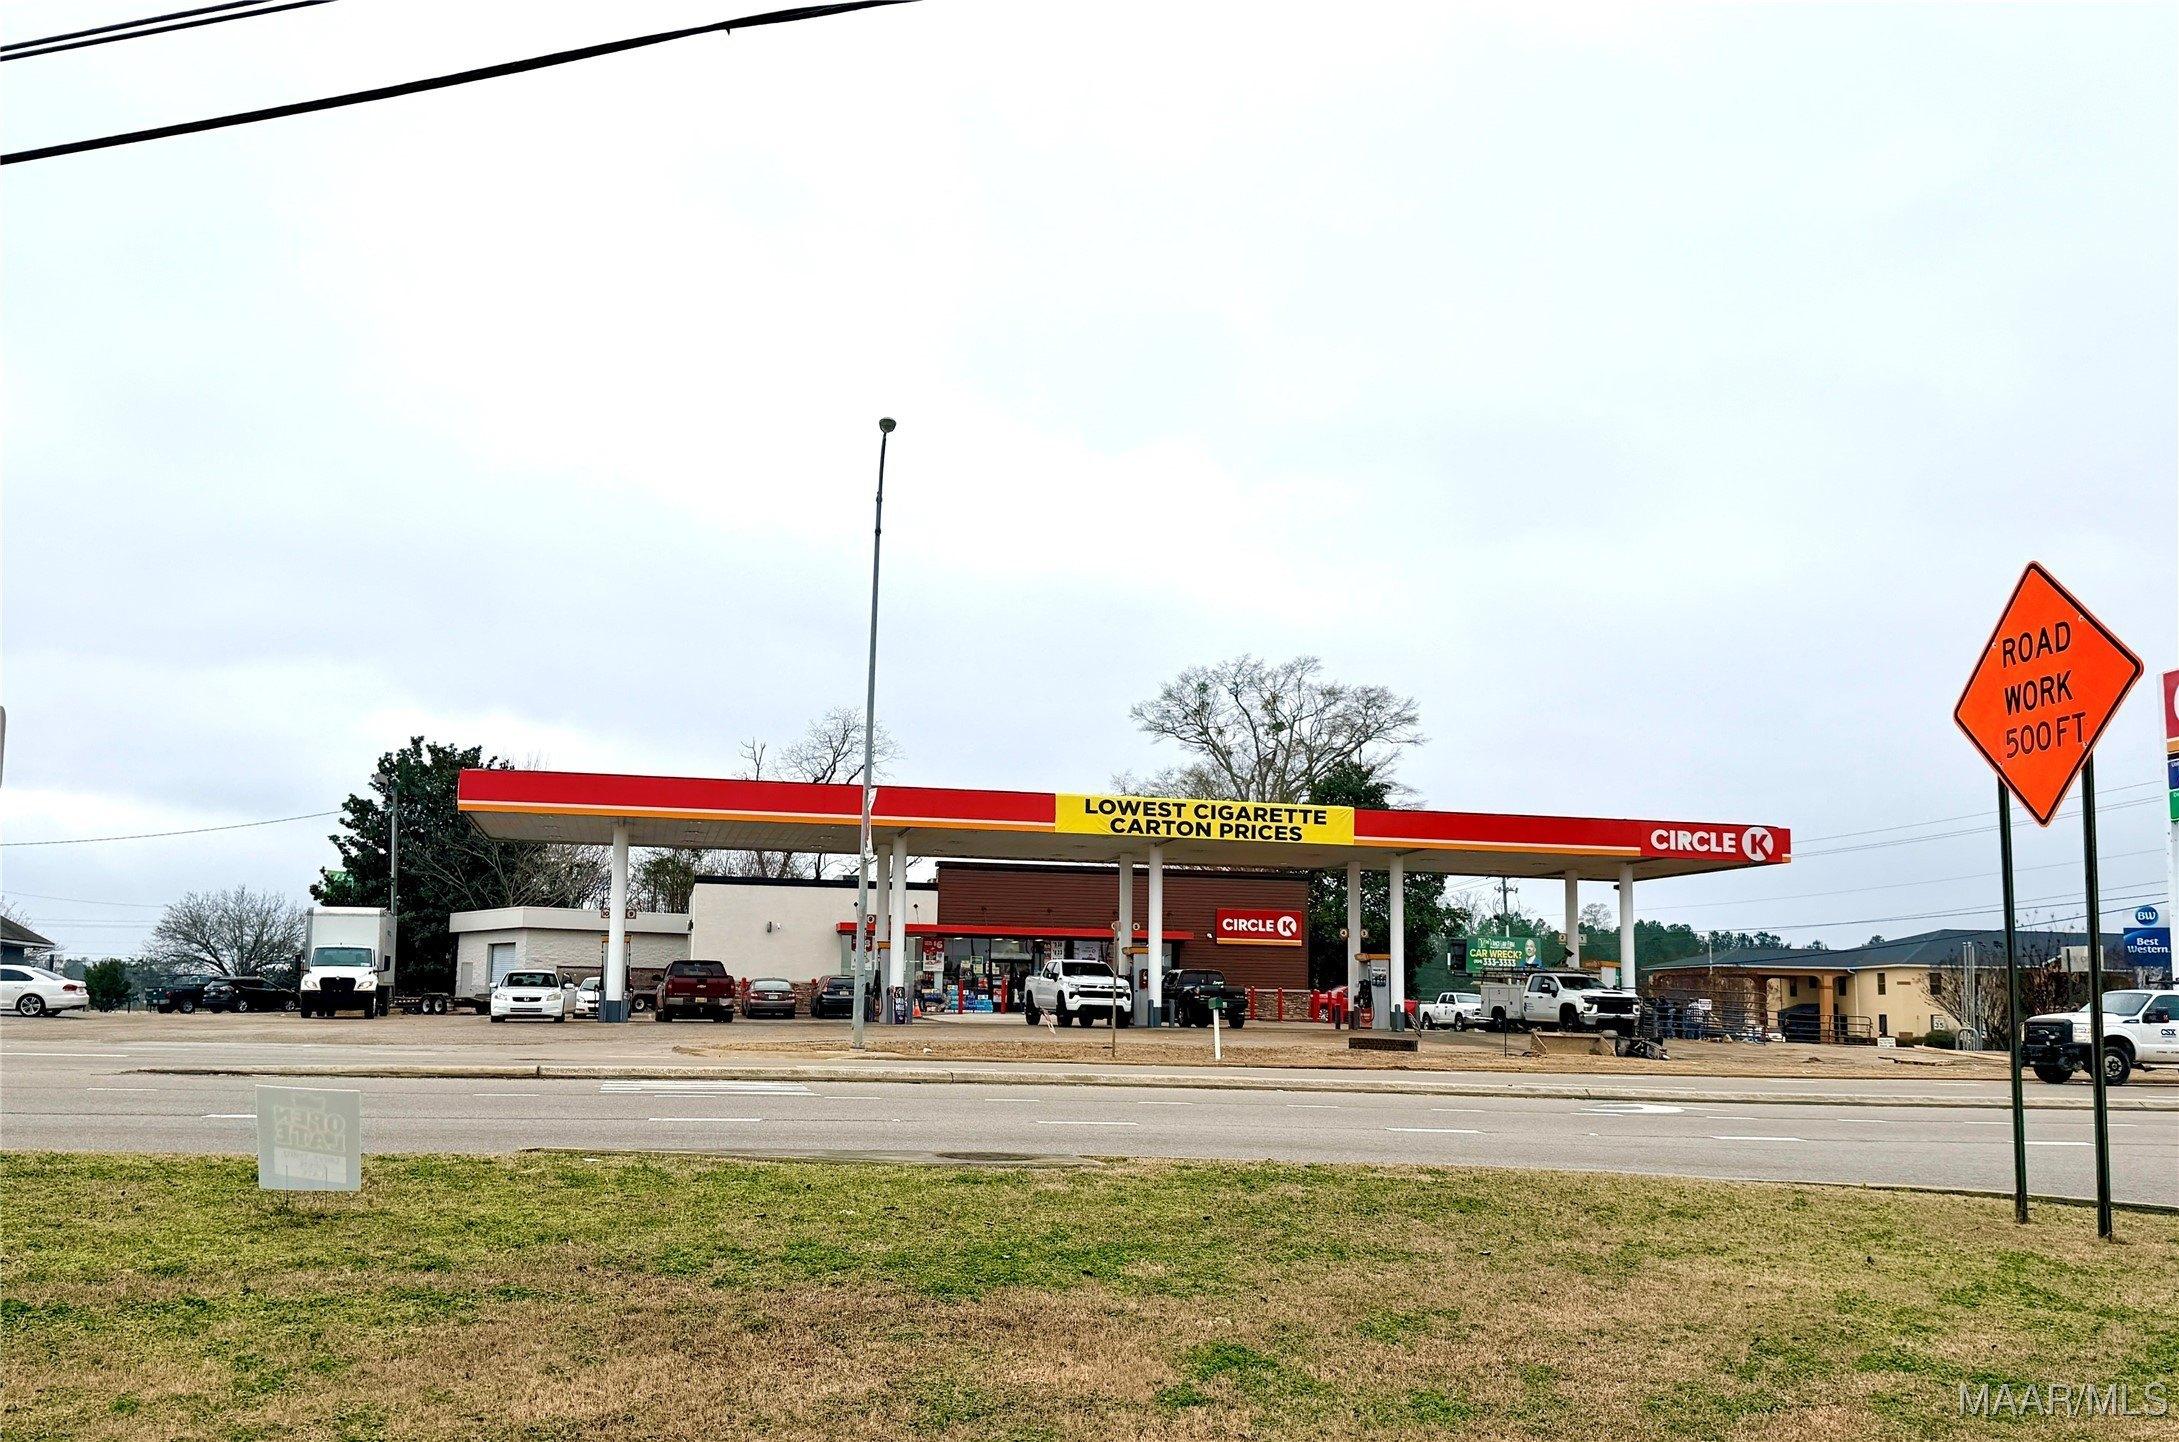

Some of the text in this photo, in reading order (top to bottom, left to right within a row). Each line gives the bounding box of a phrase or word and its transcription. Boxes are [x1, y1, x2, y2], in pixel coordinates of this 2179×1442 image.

[2002, 621, 2072, 668] ROAD
[2004, 669, 2074, 716] WORK
[1085, 798, 1327, 825] LOWEST CIGARETTE
[1110, 817, 1303, 842] CARTON PRICES
[1650, 829, 1773, 861] CIRCLE K
[2137, 911, 2156, 921] BW
[1222, 918, 1297, 936] CIRCLE K
[2137, 937, 2159, 946] Best
[1469, 948, 1523, 959] CAR WRECK?
[1482, 957, 1517, 967] 333-3333
[2161, 1028, 2177, 1036] CSX
